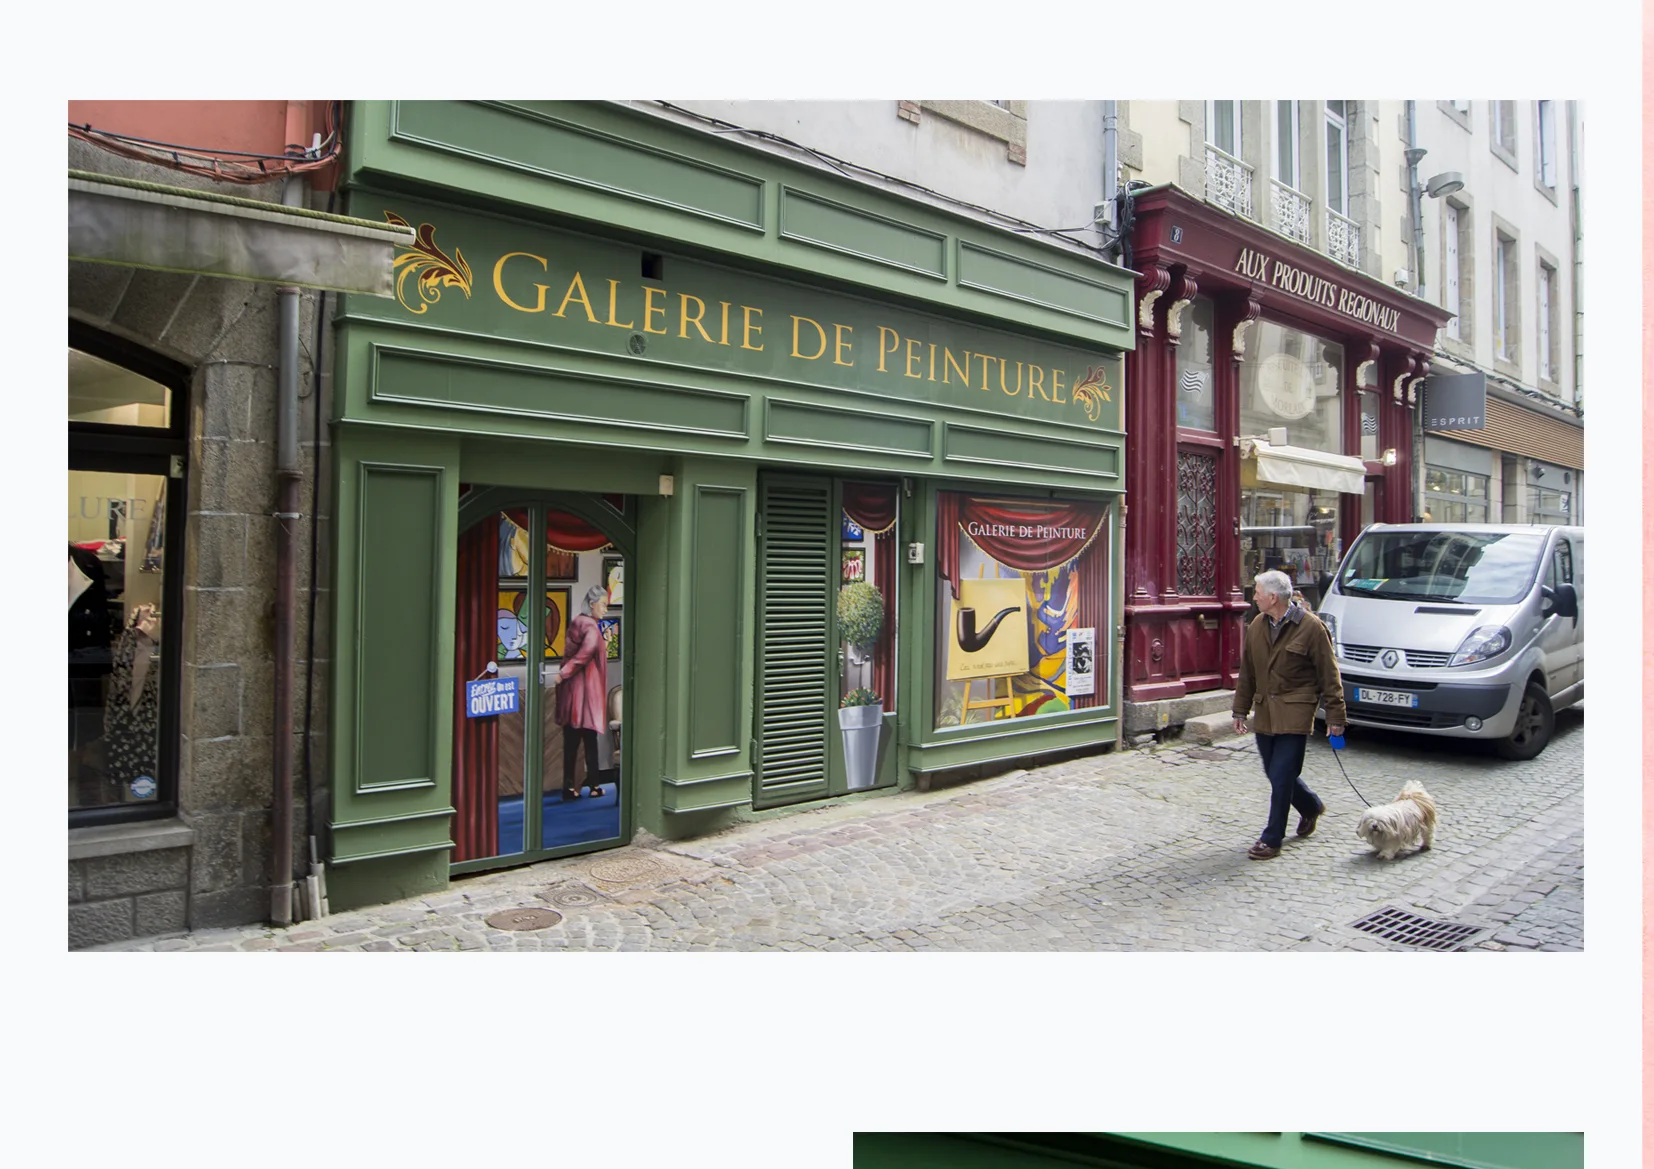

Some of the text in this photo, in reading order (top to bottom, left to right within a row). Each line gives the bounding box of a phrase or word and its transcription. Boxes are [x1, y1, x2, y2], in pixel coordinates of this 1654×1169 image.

[1235, 248, 1400, 333] AUX PRODUITS REGIONAUX
[790, 315, 853, 367] DE
[1431, 416, 1480, 426] ESPRIT
[69, 496, 147, 520] URE
[1019, 526, 1033, 538] DE
[471, 693, 515, 714] OUVERT
[1361, 689, 1410, 704] DL-728-FY
